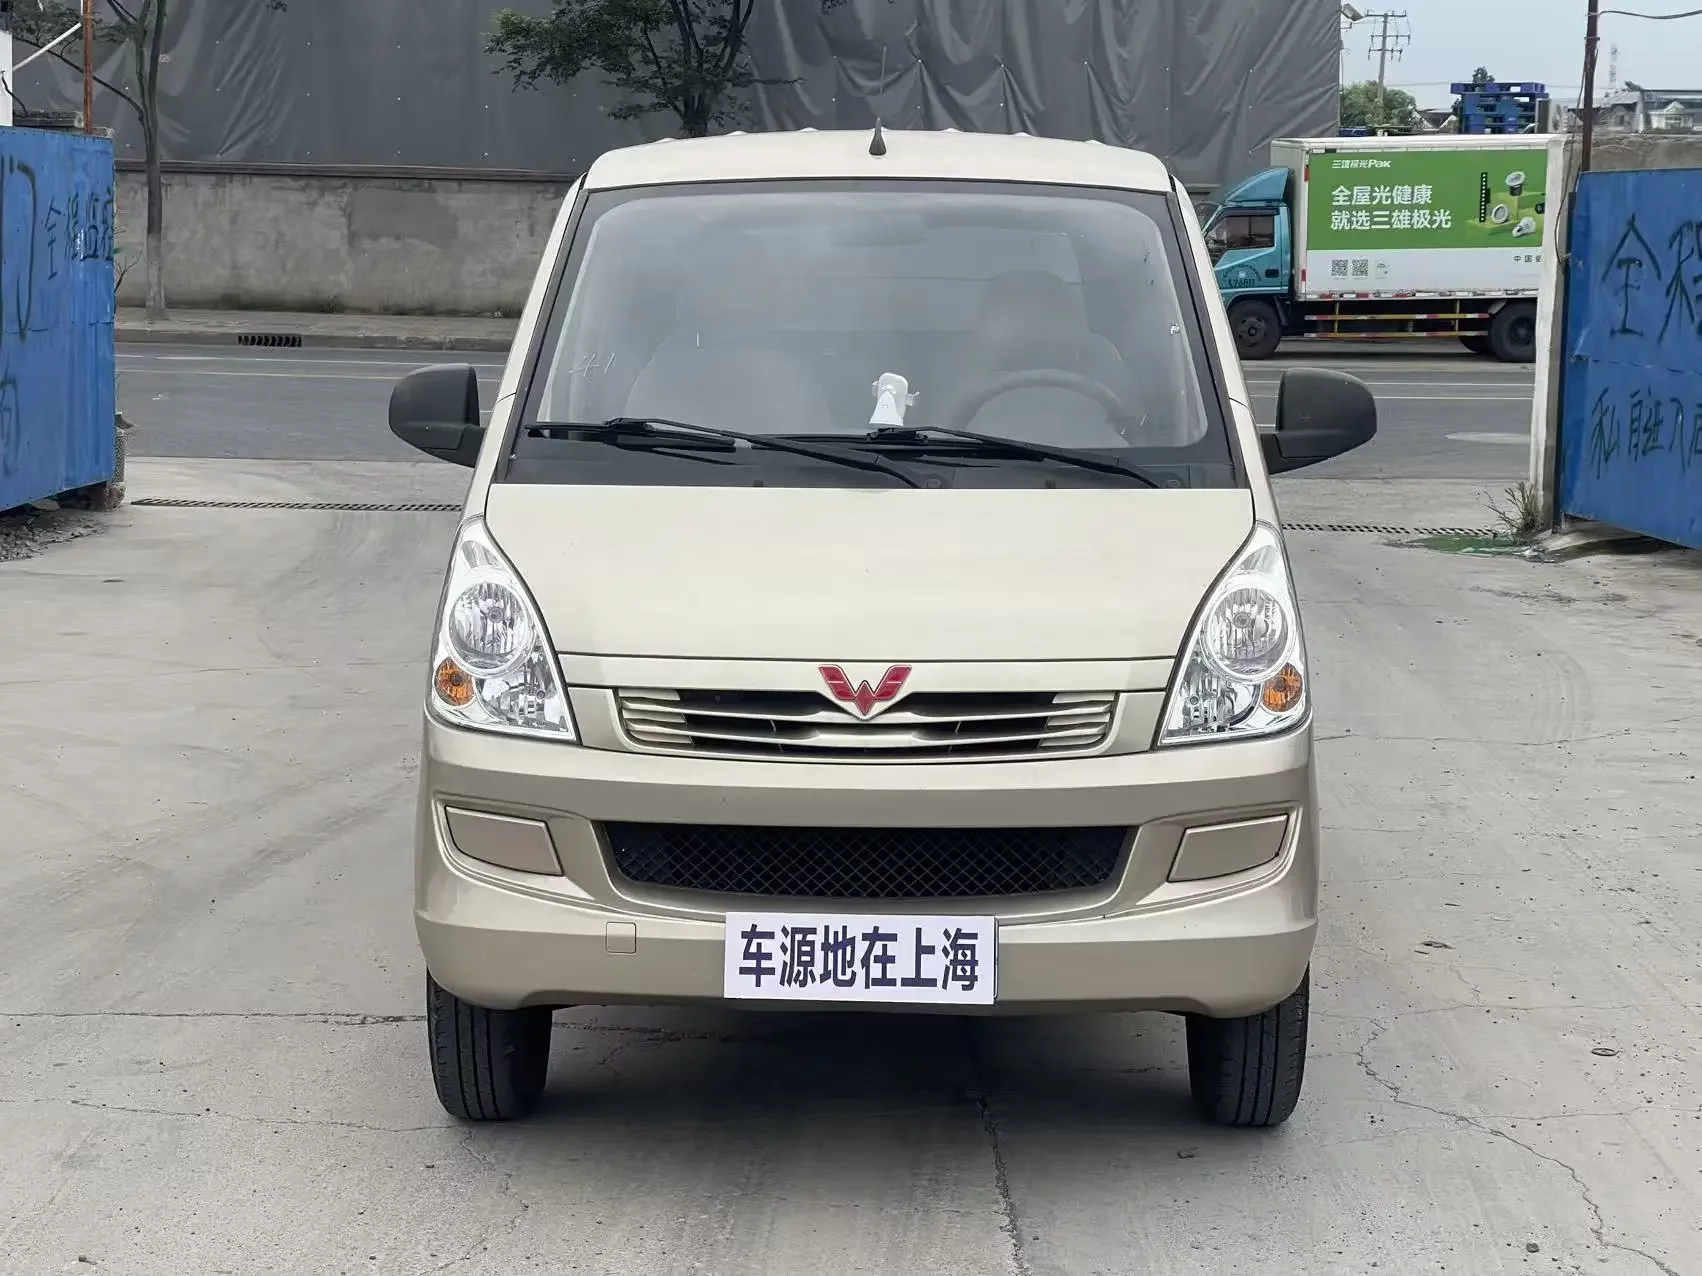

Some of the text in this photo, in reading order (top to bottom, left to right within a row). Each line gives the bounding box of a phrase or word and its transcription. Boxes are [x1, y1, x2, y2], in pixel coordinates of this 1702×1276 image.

[1332, 184, 1433, 206] 全屋光健康
[1331, 209, 1452, 230] 就选三雄极光
[738, 923, 979, 992] 车源地在上海
